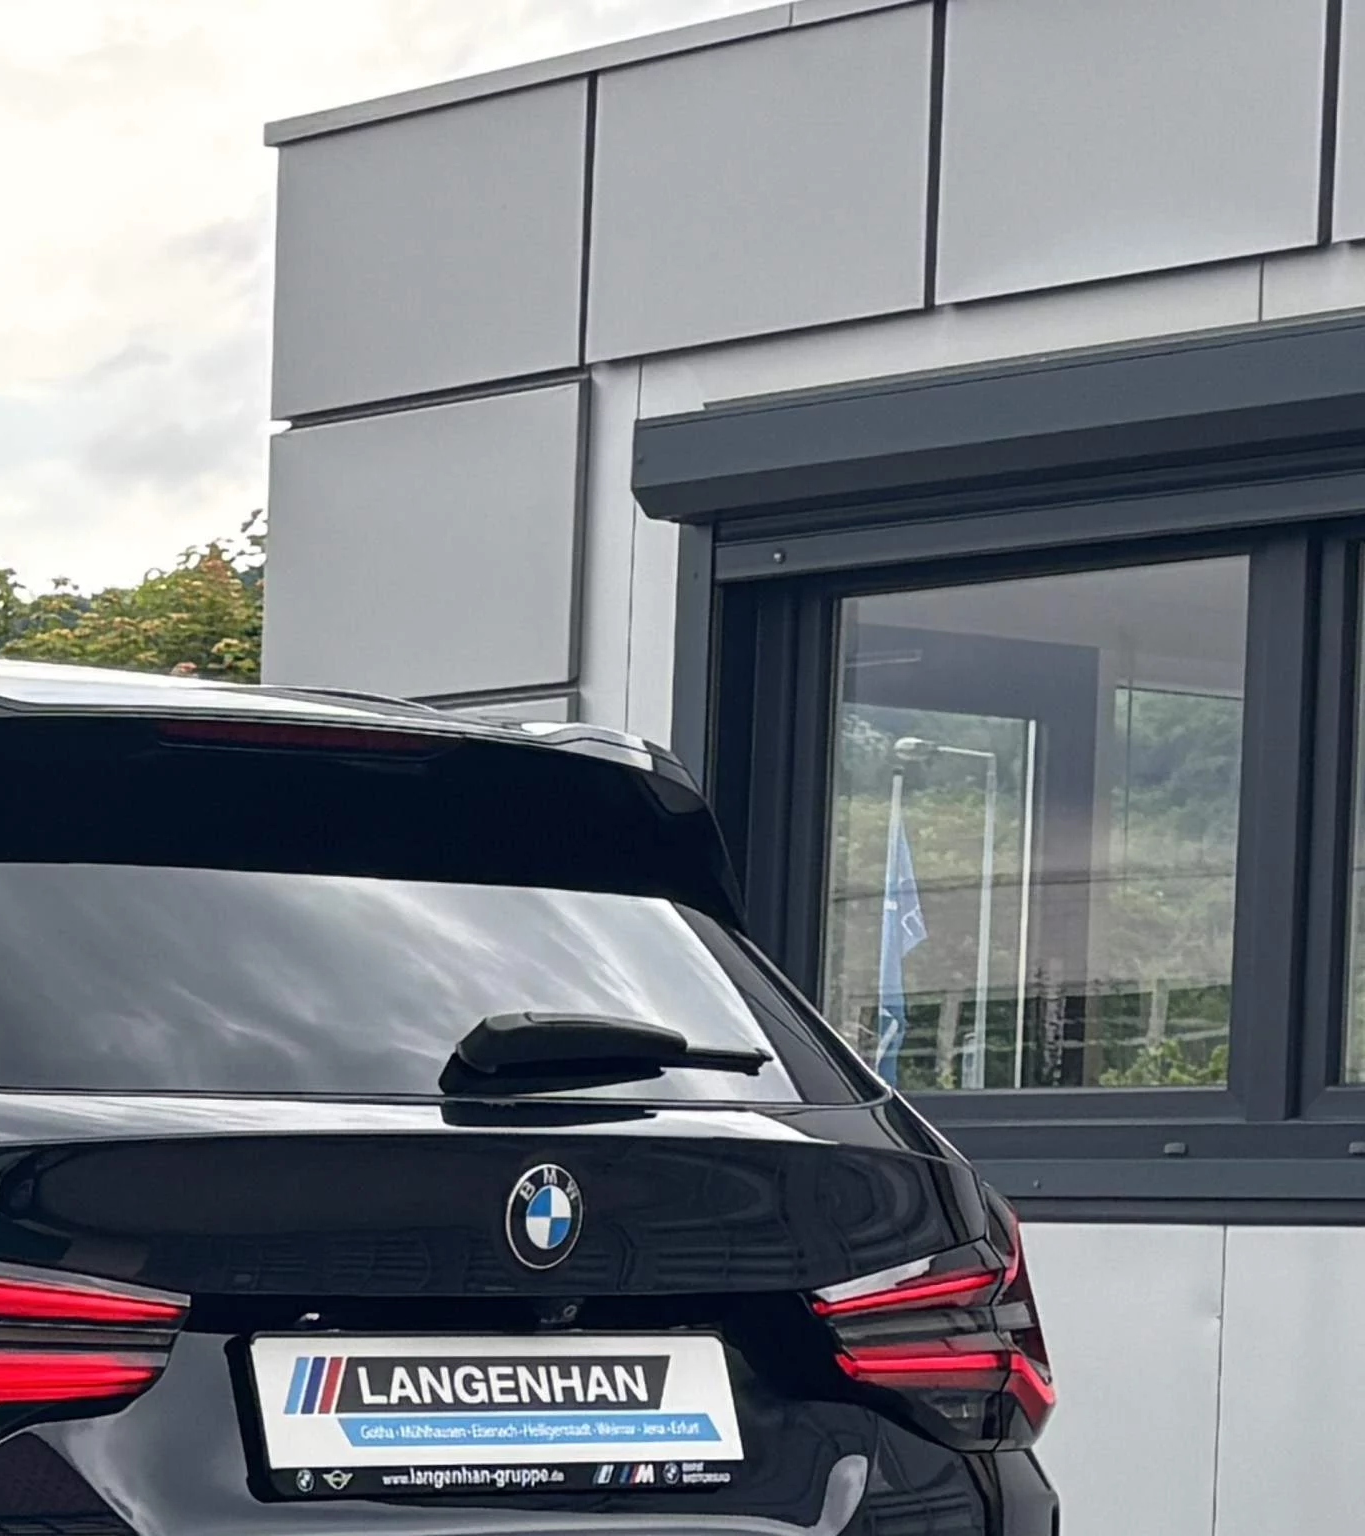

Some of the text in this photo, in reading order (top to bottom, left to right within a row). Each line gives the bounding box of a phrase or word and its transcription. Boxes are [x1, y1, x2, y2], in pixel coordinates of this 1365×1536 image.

[519, 1167, 581, 1201] BMW
[357, 1364, 649, 1405] LANGENHAN
[381, 1465, 565, 1489] www.langenhan-gruppe.de
